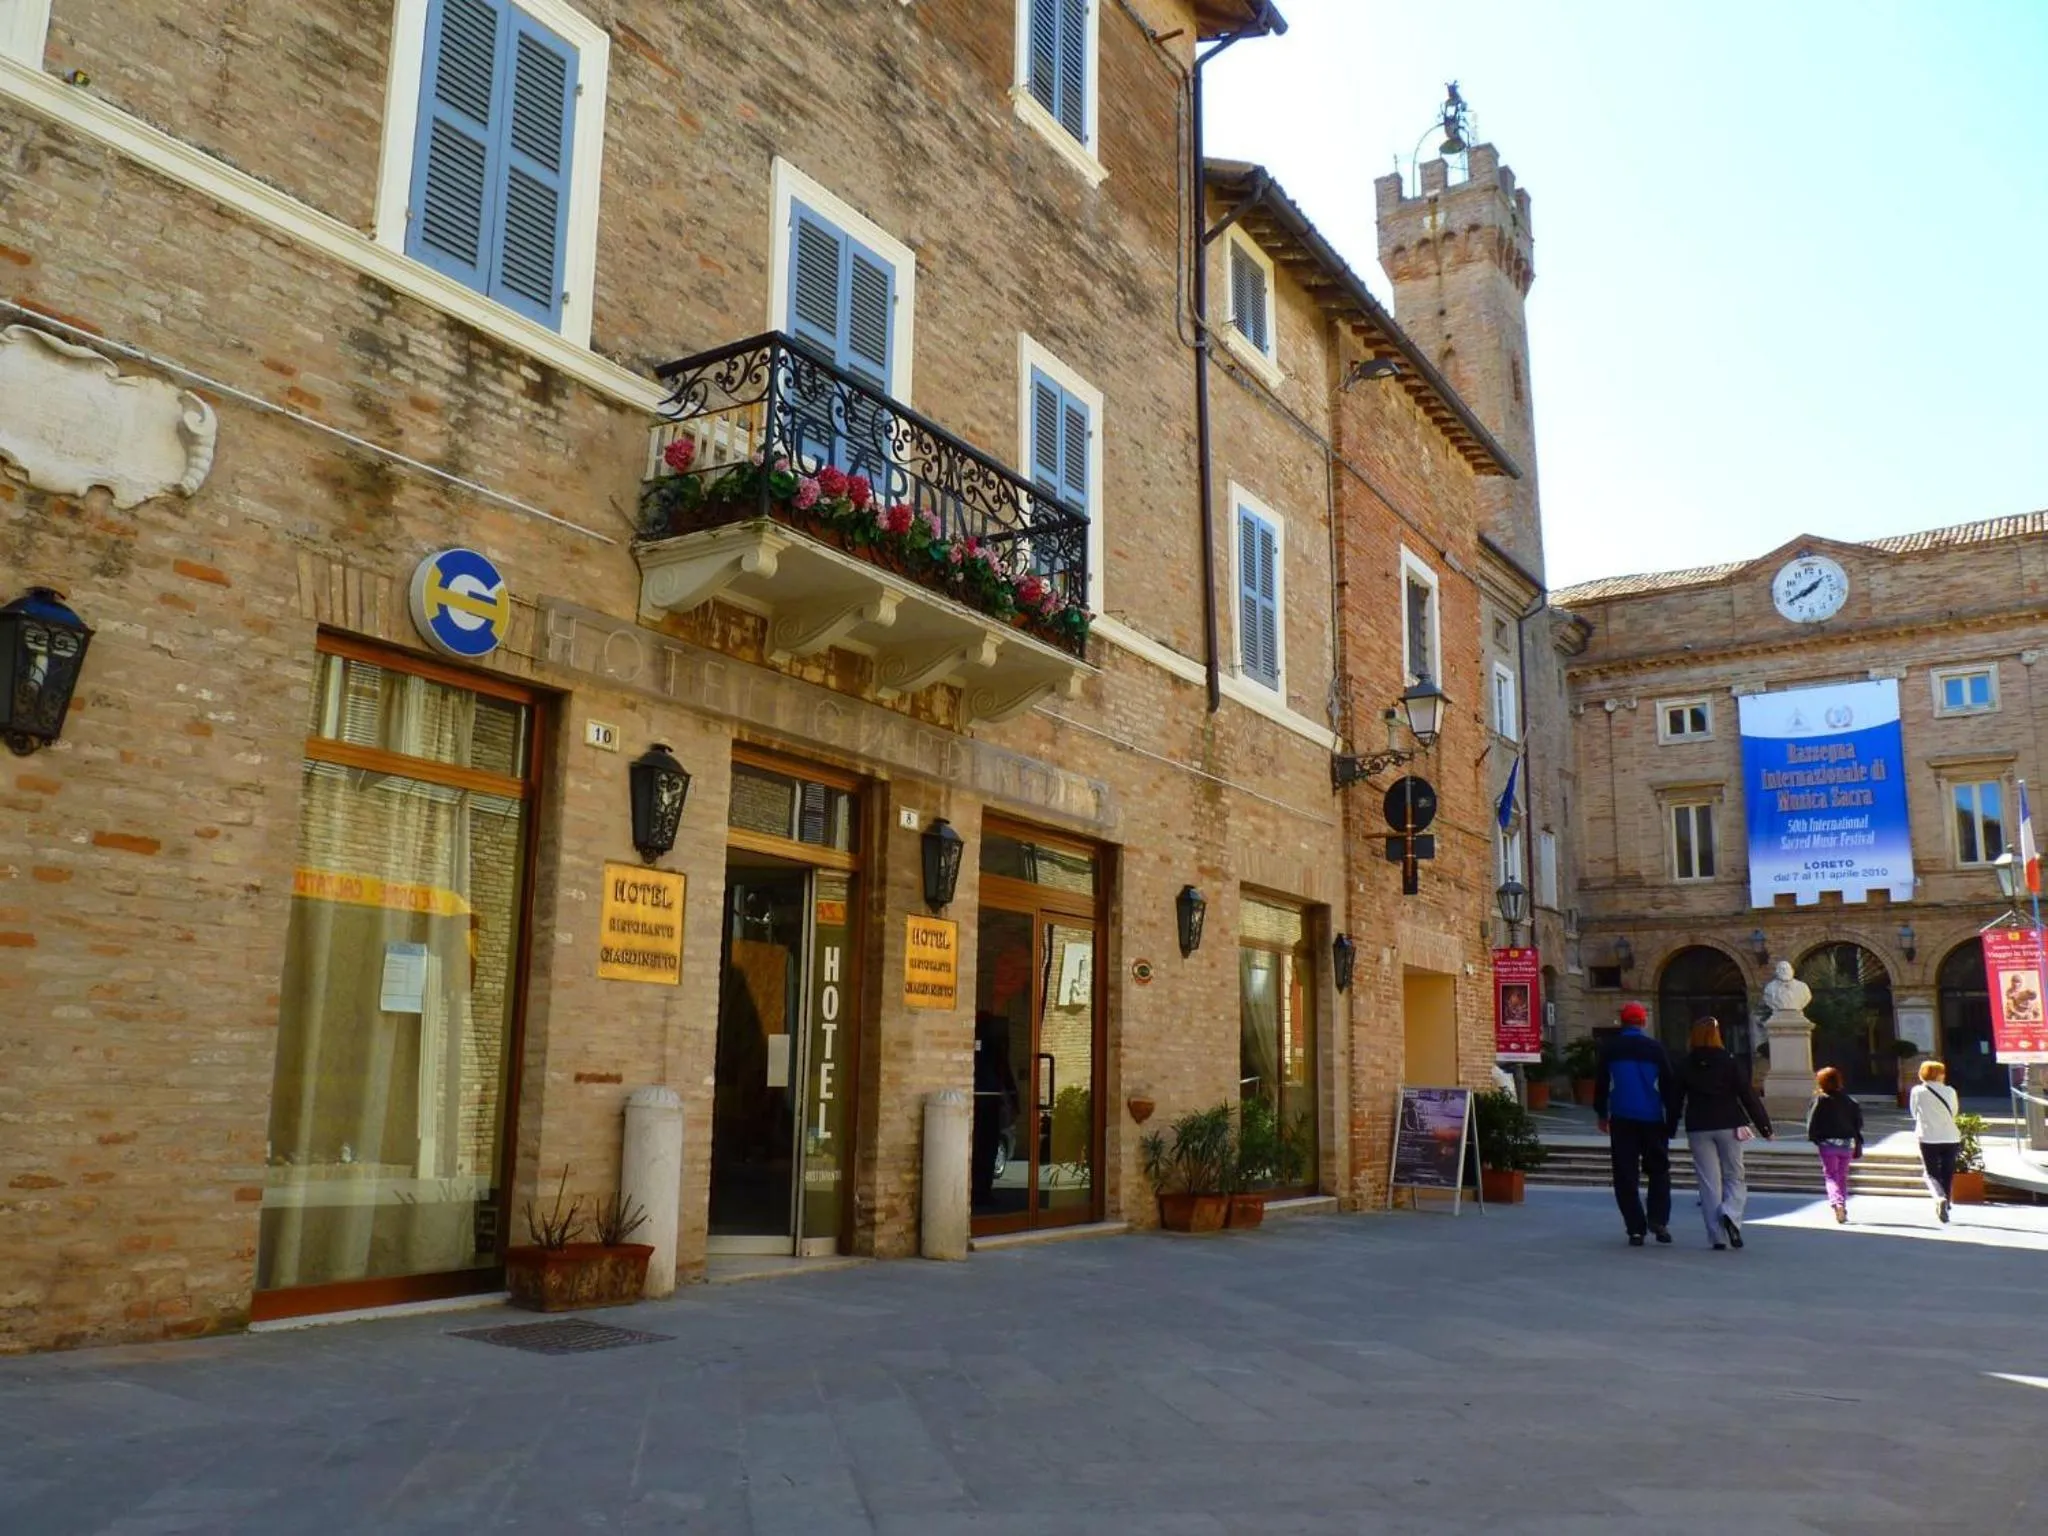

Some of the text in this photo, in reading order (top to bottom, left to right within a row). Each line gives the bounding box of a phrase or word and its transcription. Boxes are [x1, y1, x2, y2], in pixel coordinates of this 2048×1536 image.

[594, 727, 612, 745] 10
[1787, 743, 1856, 764] Rassegna
[1760, 758, 1886, 790] Internazionale di
[1777, 786, 1873, 812] Musica Sacra
[1788, 814, 1870, 833] 50th International
[1781, 830, 1875, 850] Sacred Music Festival
[1773, 867, 1889, 882] dal 7 al 11 aprile 2010
[1804, 859, 1855, 870] LORETO
[614, 878, 673, 909] HOTEL
[609, 917, 674, 938] RISTORANTE
[912, 927, 951, 950] HOTEL
[601, 946, 677, 969] GIARDINETTO
[819, 946, 840, 1139] HOTEL
